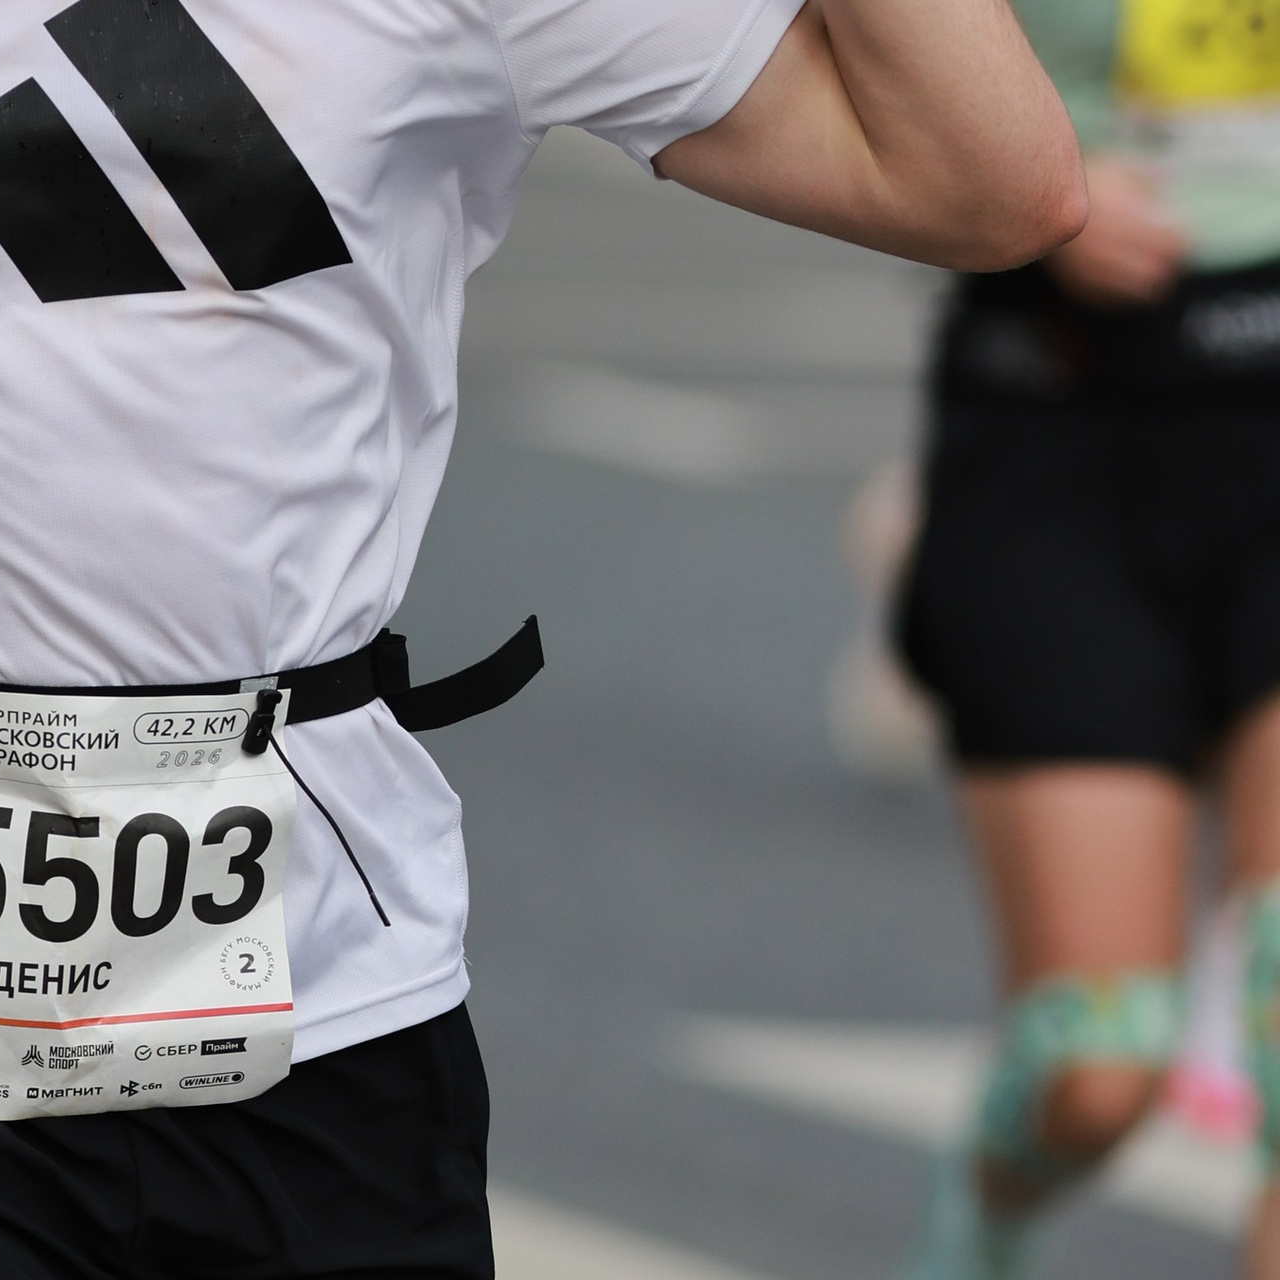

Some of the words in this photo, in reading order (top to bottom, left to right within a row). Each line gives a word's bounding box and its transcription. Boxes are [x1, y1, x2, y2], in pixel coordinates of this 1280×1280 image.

[147, 718, 195, 739] 42,2
[203, 715, 237, 735] КМ
[156, 748, 222, 768] 2026
[220, 942, 233, 963] БЕГУ
[236, 936, 275, 983] МОСКОВСКИЙ
[238, 953, 256, 974] 2
[221, 967, 262, 991] МАРАФОН
[49, 1040, 114, 1058] МОСКОВСКИЙ
[156, 1044, 197, 1057] СБЕР
[205, 1041, 239, 1052] Прайм
[49, 1058, 80, 1069] СПОРТ
[184, 1075, 230, 1087] WINLINE
